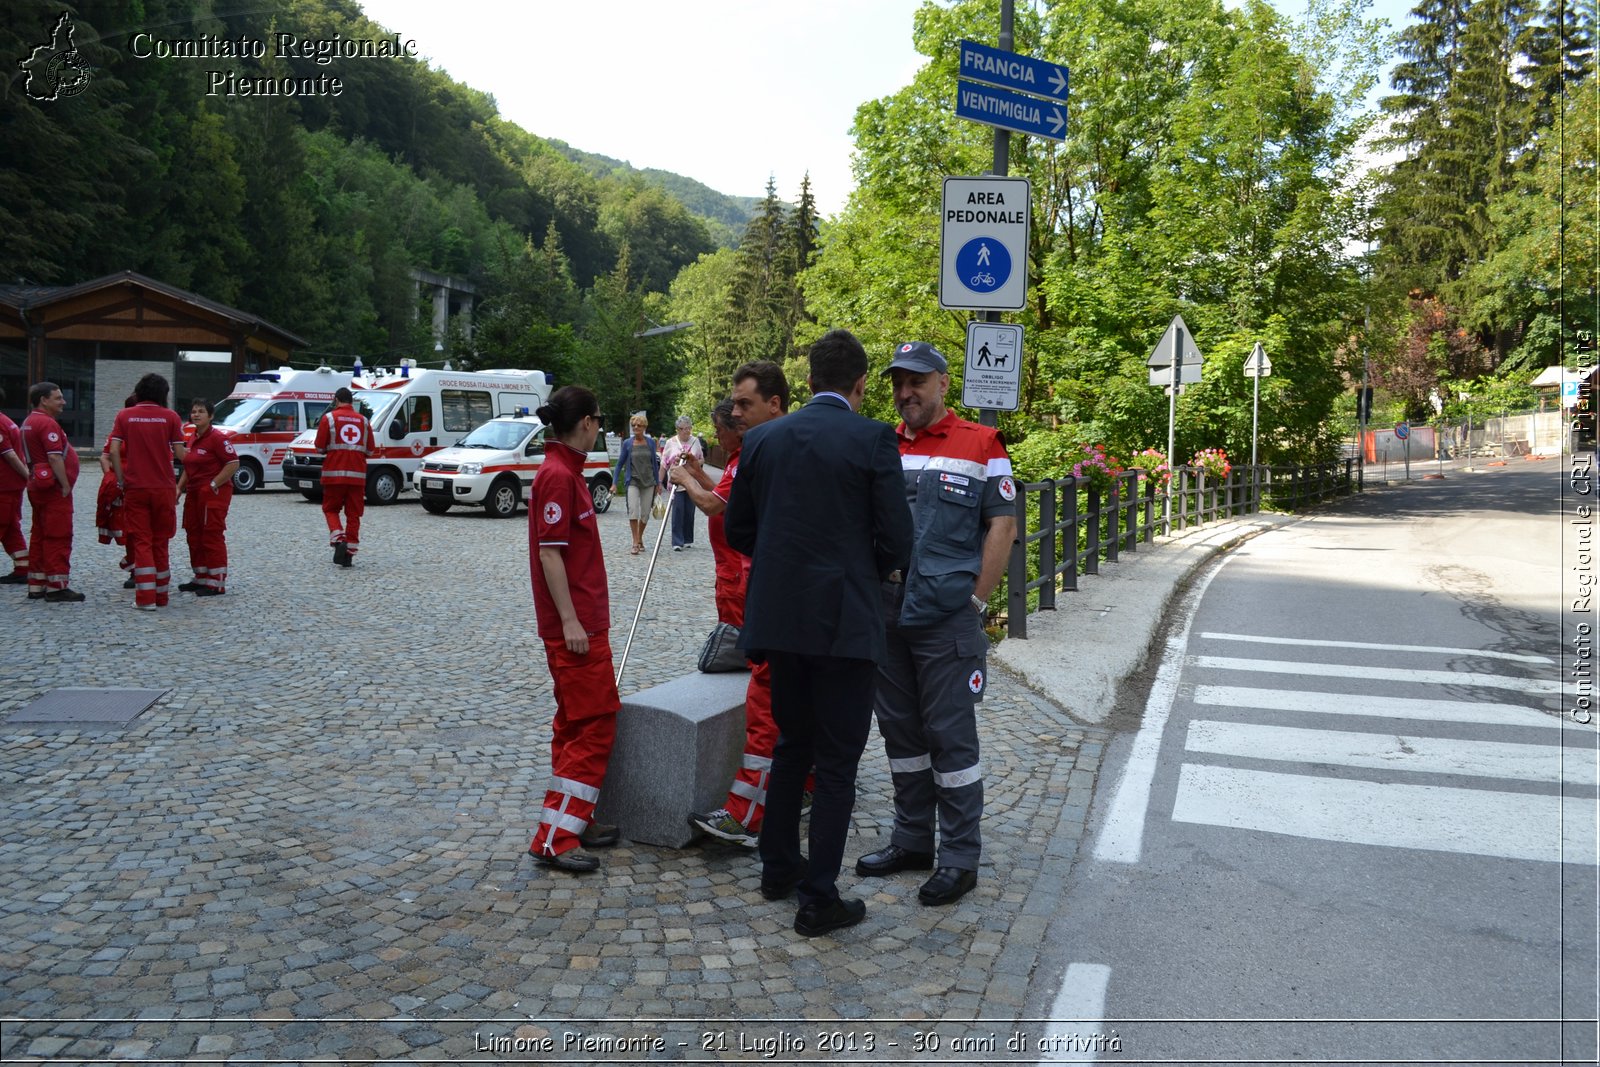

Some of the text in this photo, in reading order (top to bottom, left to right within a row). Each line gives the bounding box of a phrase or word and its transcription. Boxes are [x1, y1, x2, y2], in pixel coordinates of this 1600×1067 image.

[964, 50, 1035, 84] FRANCIA
[962, 90, 1041, 125] VENTIMIGLIA
[967, 192, 1005, 205] AREA
[947, 210, 1025, 224] PEDONALE
[439, 379, 458, 387] CROCE
[458, 380, 477, 388] ROSSA
[477, 381, 500, 389] ITALIANA
[501, 382, 519, 390] LIMONE
[1563, 382, 1575, 396] P
